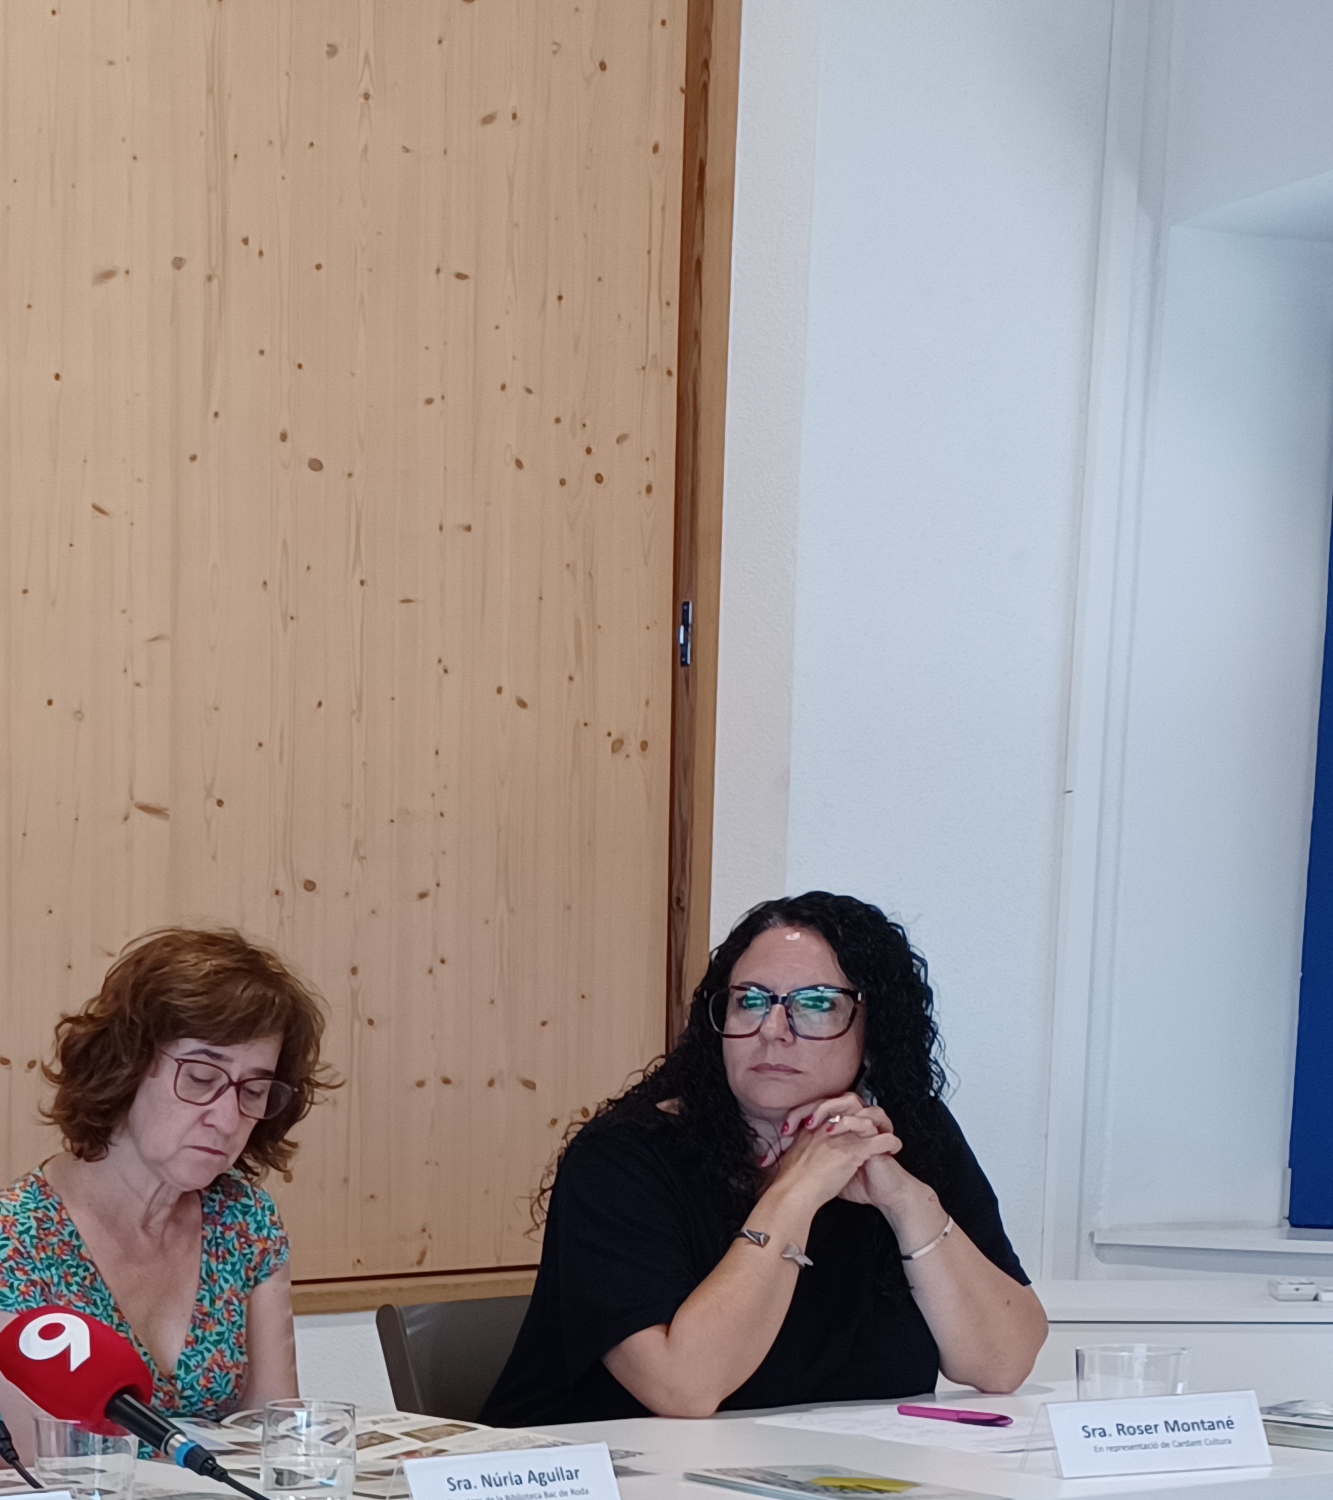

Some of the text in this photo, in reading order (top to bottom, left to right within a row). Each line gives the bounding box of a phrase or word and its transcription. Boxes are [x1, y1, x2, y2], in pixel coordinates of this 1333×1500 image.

[18, 1312, 91, 1372] 9
[1081, 1415, 1235, 1439] Sra. Roser Montané
[446, 1466, 580, 1492] Sra. Núria Aguilar
